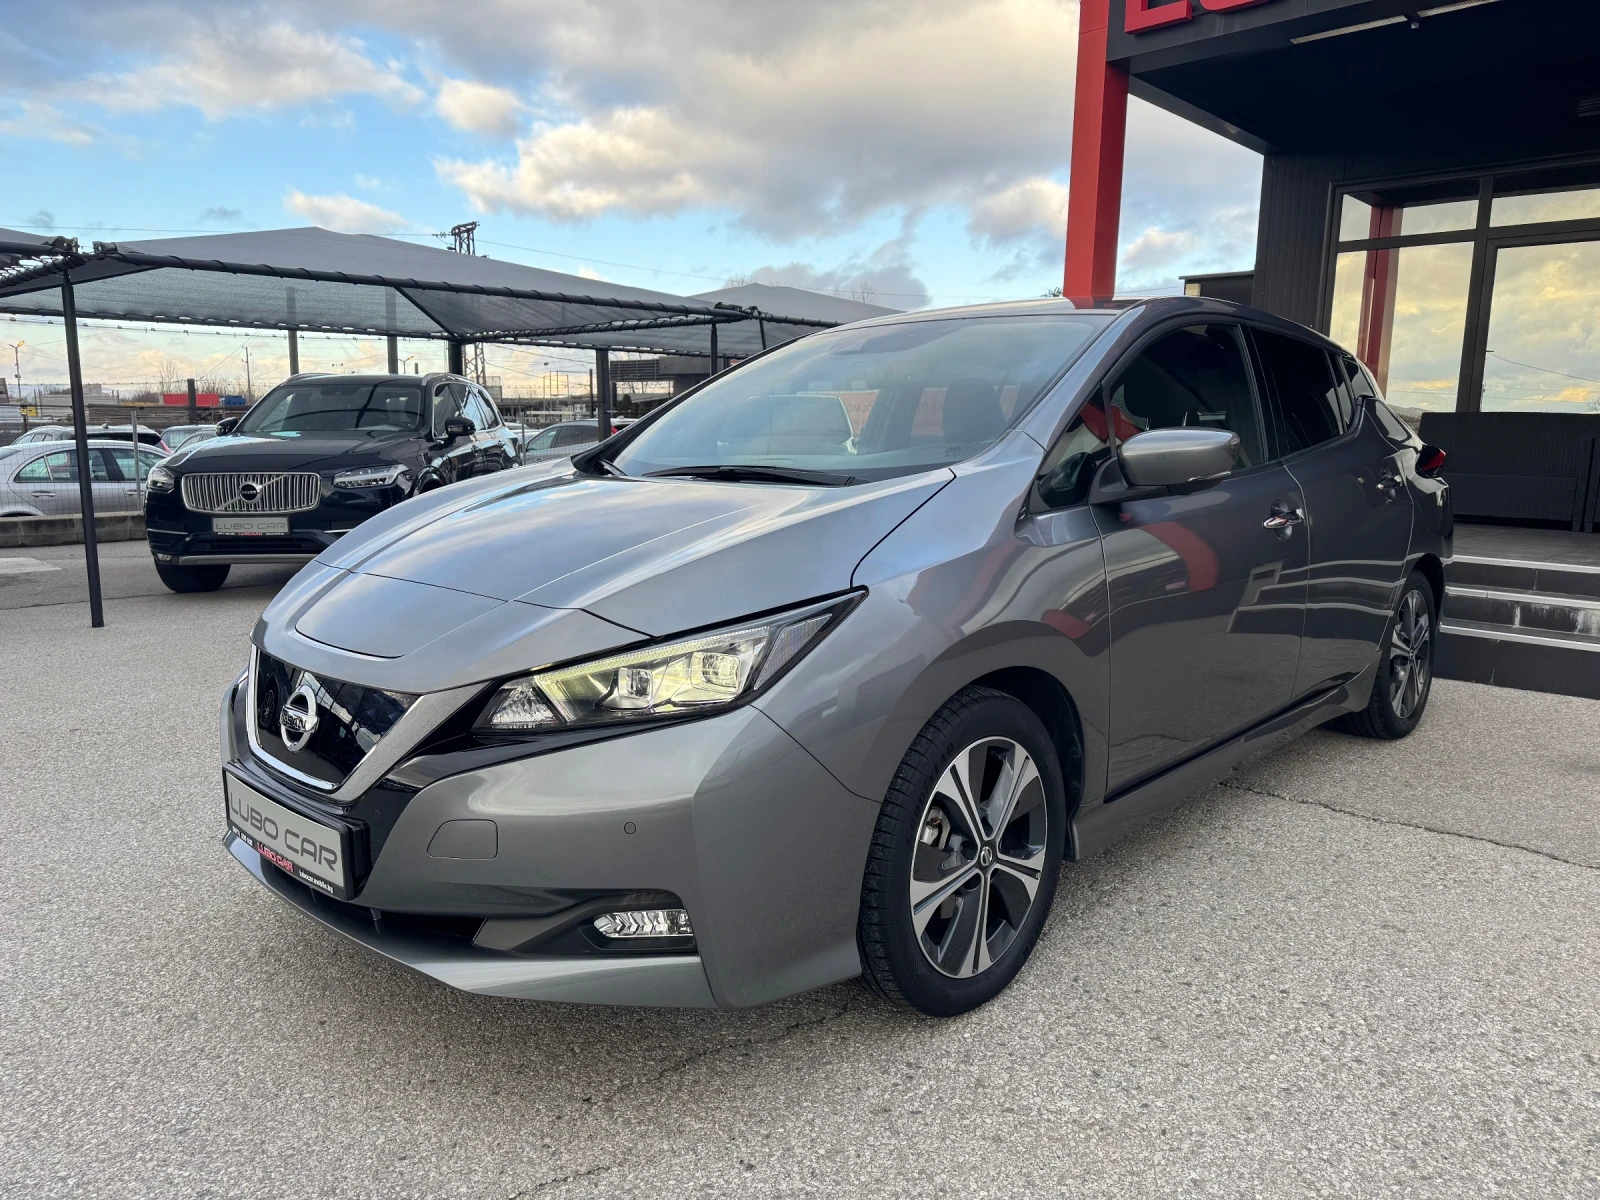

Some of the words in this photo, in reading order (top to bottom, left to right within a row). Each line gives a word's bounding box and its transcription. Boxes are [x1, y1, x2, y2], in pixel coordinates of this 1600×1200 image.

[215, 522, 254, 530] LUBO
[256, 522, 287, 530] CAR
[230, 792, 279, 841] LUBO
[284, 828, 338, 872] CAR
